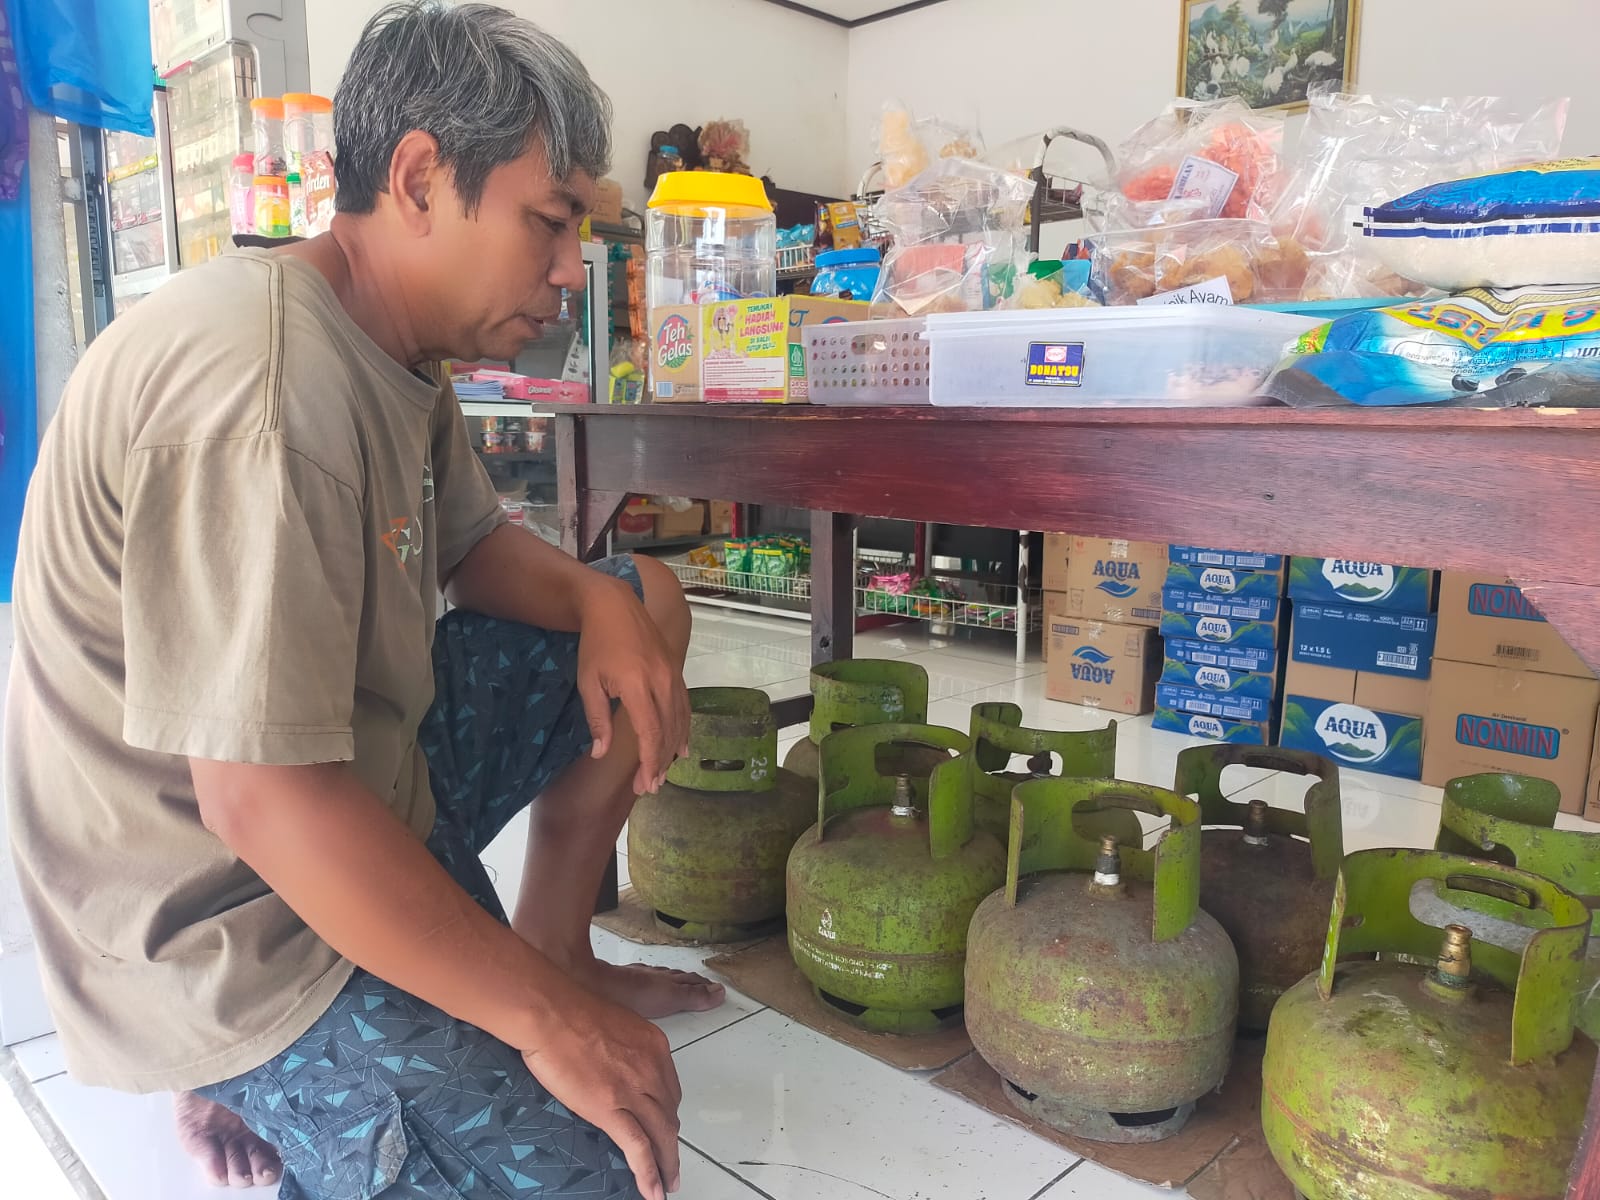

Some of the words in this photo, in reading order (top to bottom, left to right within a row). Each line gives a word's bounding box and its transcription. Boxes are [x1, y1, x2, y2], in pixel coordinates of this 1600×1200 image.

[745, 310, 776, 325] HADIAH
[663, 320, 686, 345] Teh
[739, 322, 784, 338] LANGSUNG
[657, 341, 693, 367] Gelas
[1092, 560, 1141, 581] AQUA
[1331, 560, 1384, 578] AQUA
[1204, 573, 1231, 586] AQUA
[1200, 622, 1228, 633] AQUA
[1070, 662, 1116, 685] AQUA
[1199, 671, 1227, 684] AQUA
[1192, 720, 1220, 732] AQUA
[1324, 716, 1377, 739] AQUA
[1459, 716, 1555, 756] NONMIN
